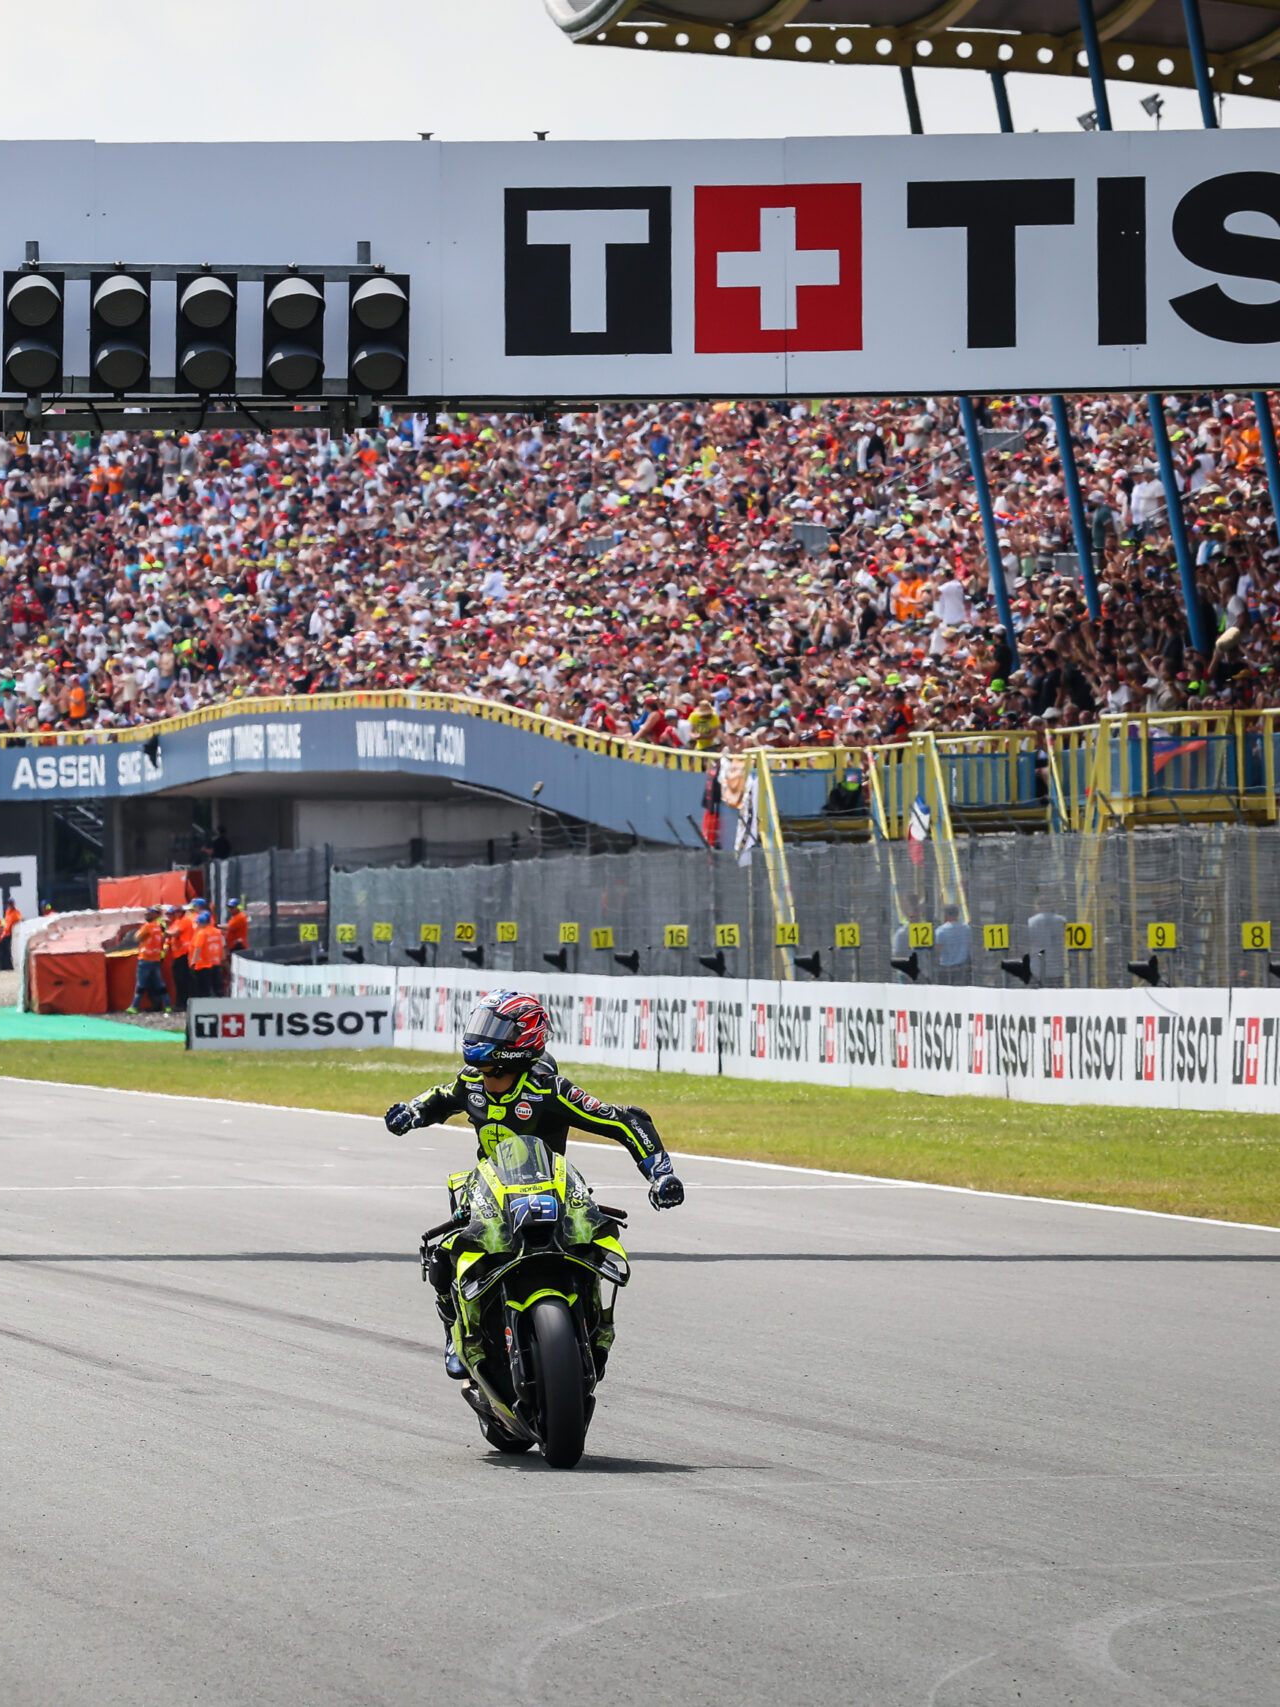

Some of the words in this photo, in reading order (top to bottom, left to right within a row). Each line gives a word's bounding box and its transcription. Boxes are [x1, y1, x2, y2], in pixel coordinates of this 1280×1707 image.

[12, 753, 106, 790] ASSEN
[456, 924, 474, 940] 20
[500, 925, 515, 941] 19
[561, 925, 576, 942] 18
[668, 928, 686, 945] 16
[719, 928, 736, 945] 15
[780, 926, 797, 944] 14
[837, 927, 858, 946] 13
[914, 927, 932, 946] 12
[988, 928, 1005, 947] 11
[1066, 928, 1087, 946] 10
[1155, 928, 1166, 945] 9
[1251, 928, 1264, 947] 8
[250, 1010, 389, 1037] TISSOT
[835, 1007, 884, 1066] TISSOT
[909, 1010, 962, 1071] TISSOT
[985, 1014, 1037, 1078] TISSOT
[1065, 1016, 1127, 1082] TISSOT
[1158, 1016, 1223, 1084] TISSOT
[516, 1106, 532, 1115] Gulf
